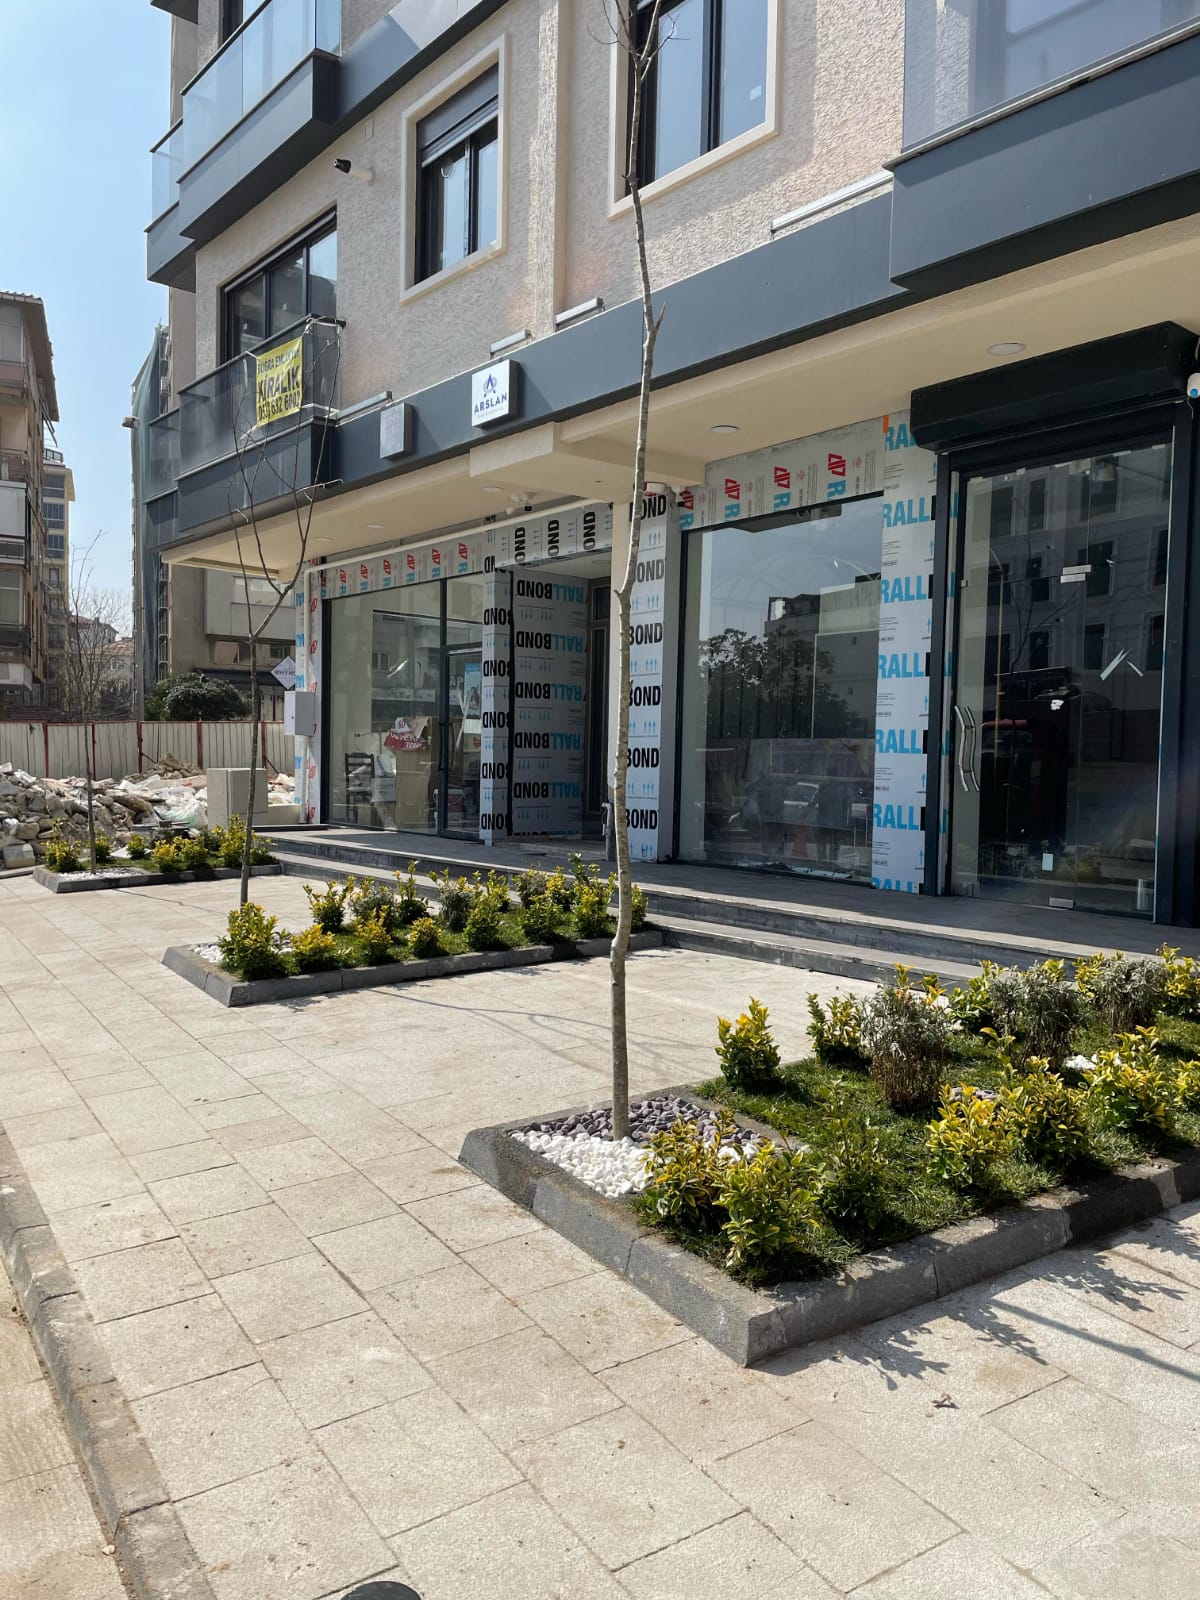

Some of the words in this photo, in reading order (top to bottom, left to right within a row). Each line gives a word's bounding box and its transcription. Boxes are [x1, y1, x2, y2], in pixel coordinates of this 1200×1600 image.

[258, 365, 300, 403] KİRALIK
[474, 393, 508, 415] ARSLAN
[882, 495, 936, 528] RALL
[879, 573, 933, 604] RALL
[877, 651, 931, 680] RALL
[875, 729, 928, 754] RALL
[872, 804, 926, 832] RALL
